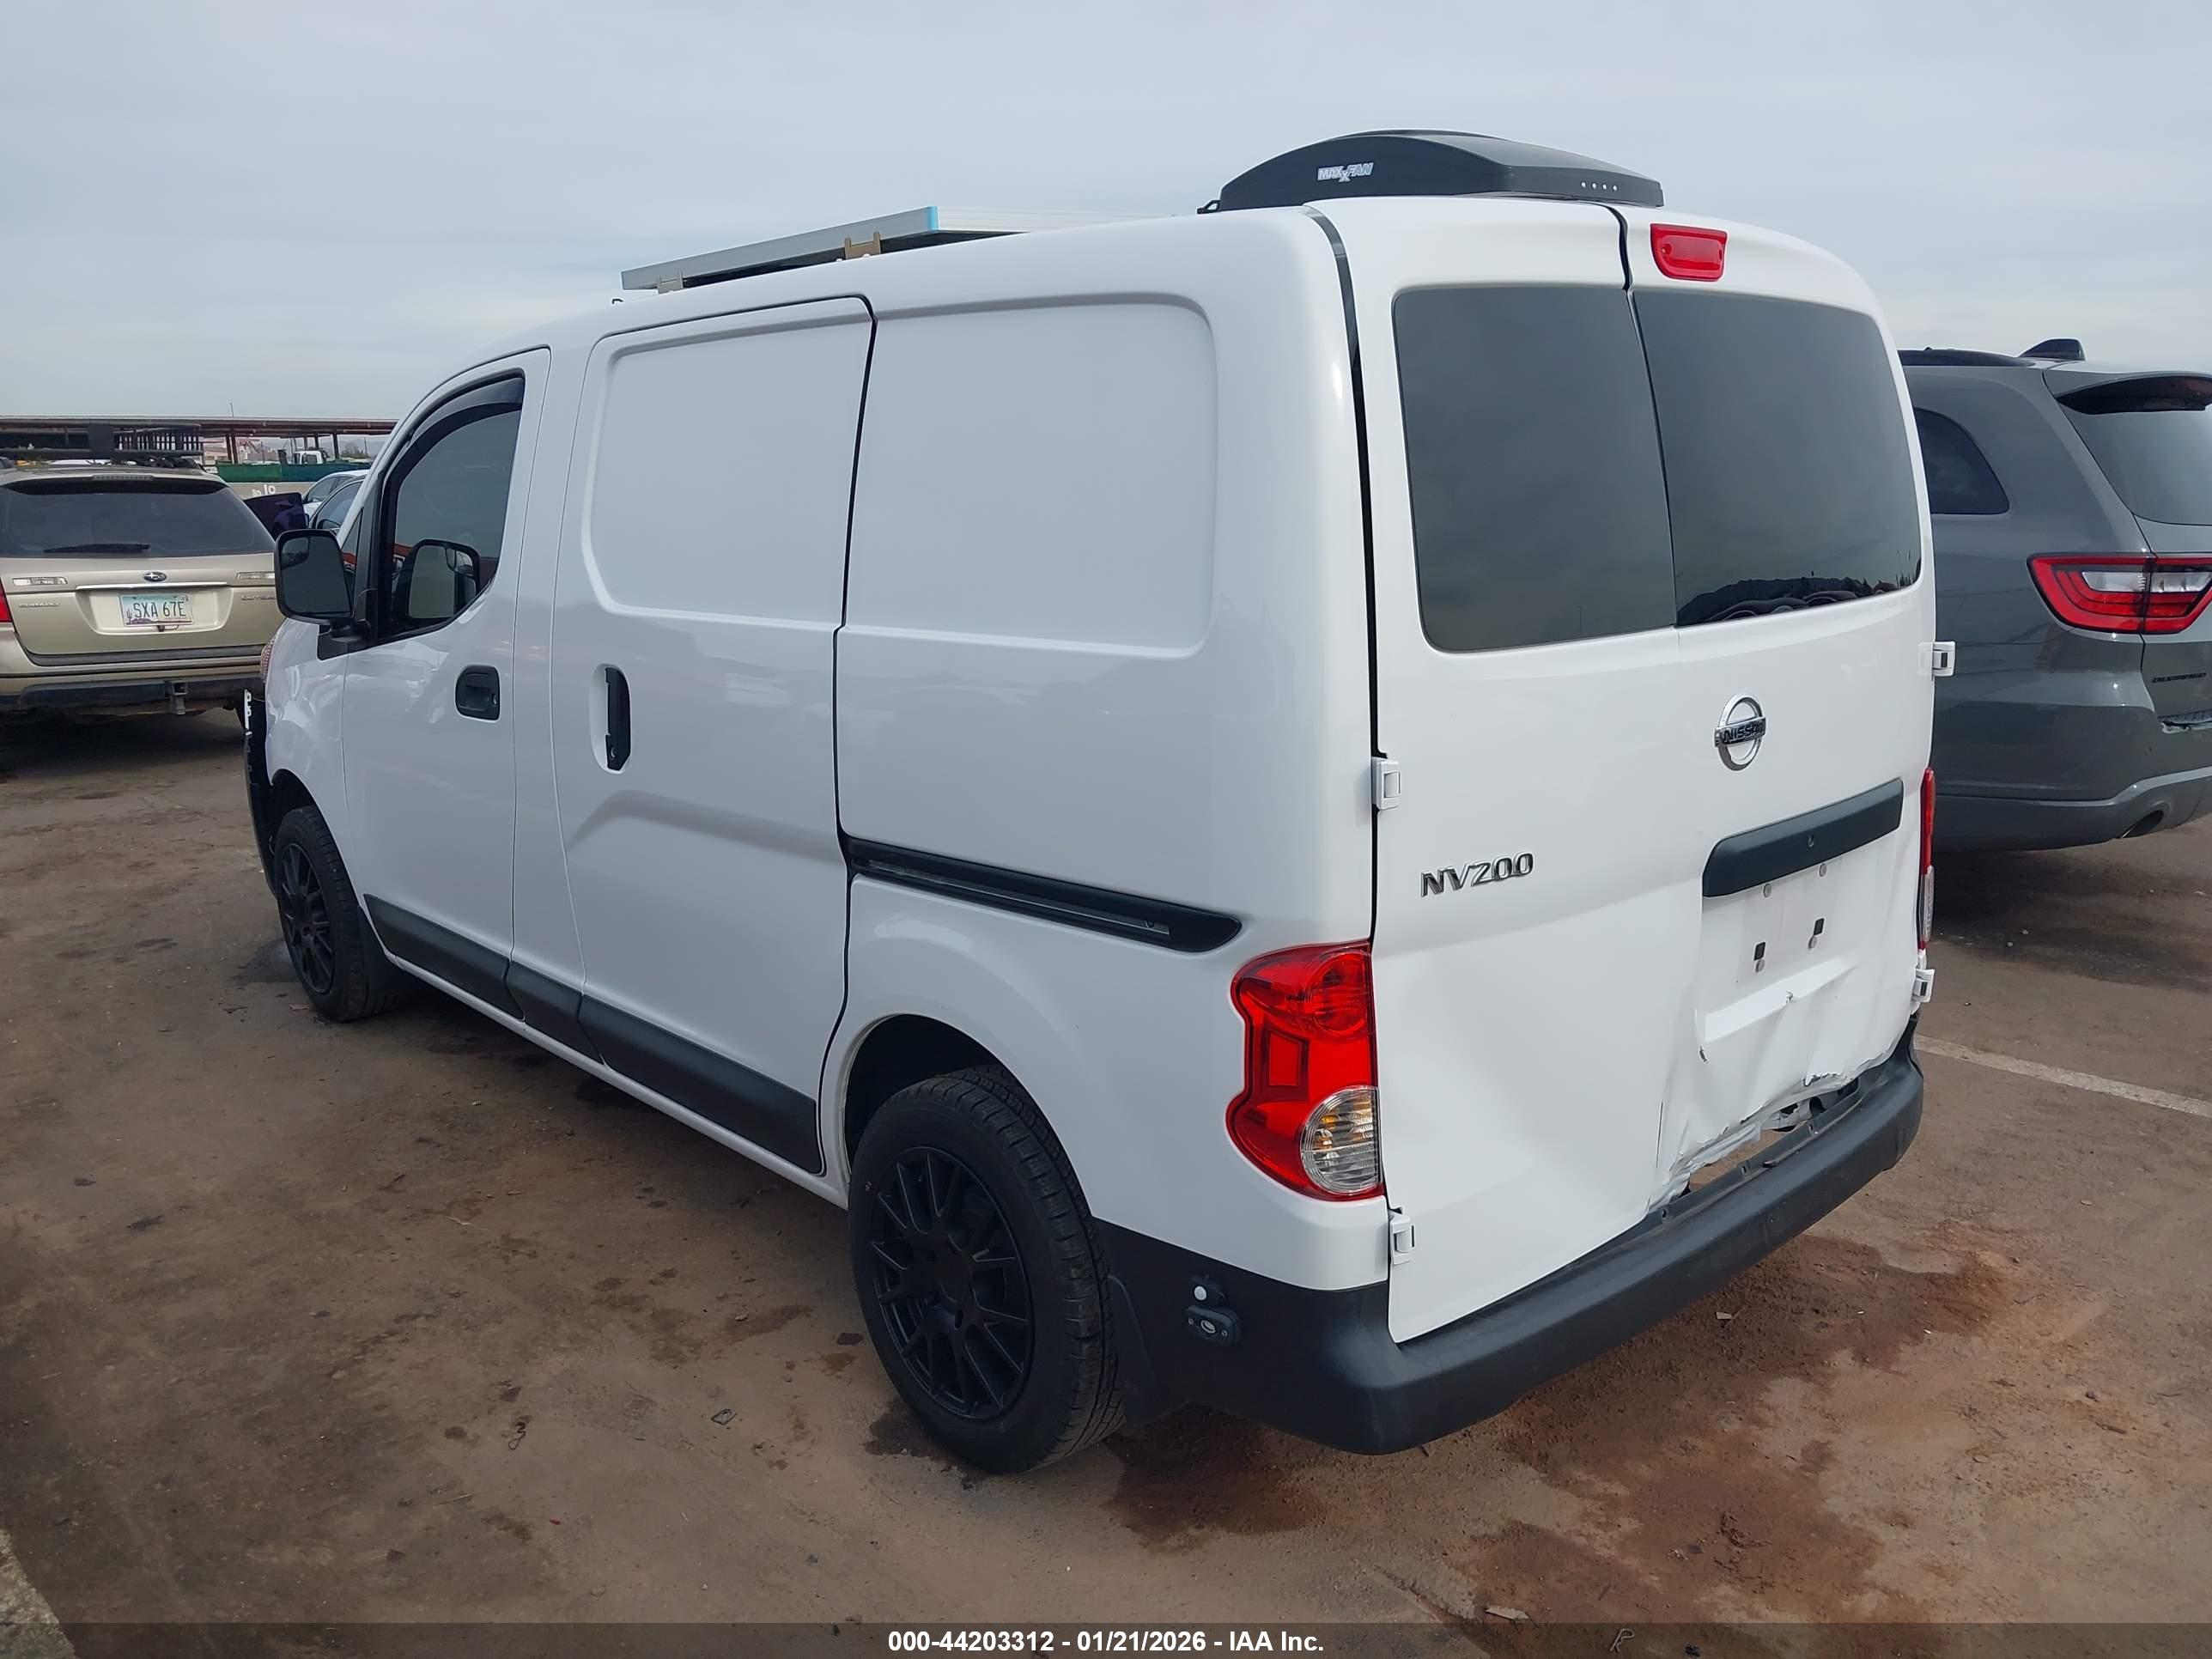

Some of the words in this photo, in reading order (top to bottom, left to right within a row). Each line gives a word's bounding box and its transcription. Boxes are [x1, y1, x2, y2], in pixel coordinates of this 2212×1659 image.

[133, 602, 159, 618] SXA
[162, 601, 186, 617] 67E
[1420, 852, 1534, 897] NV200
